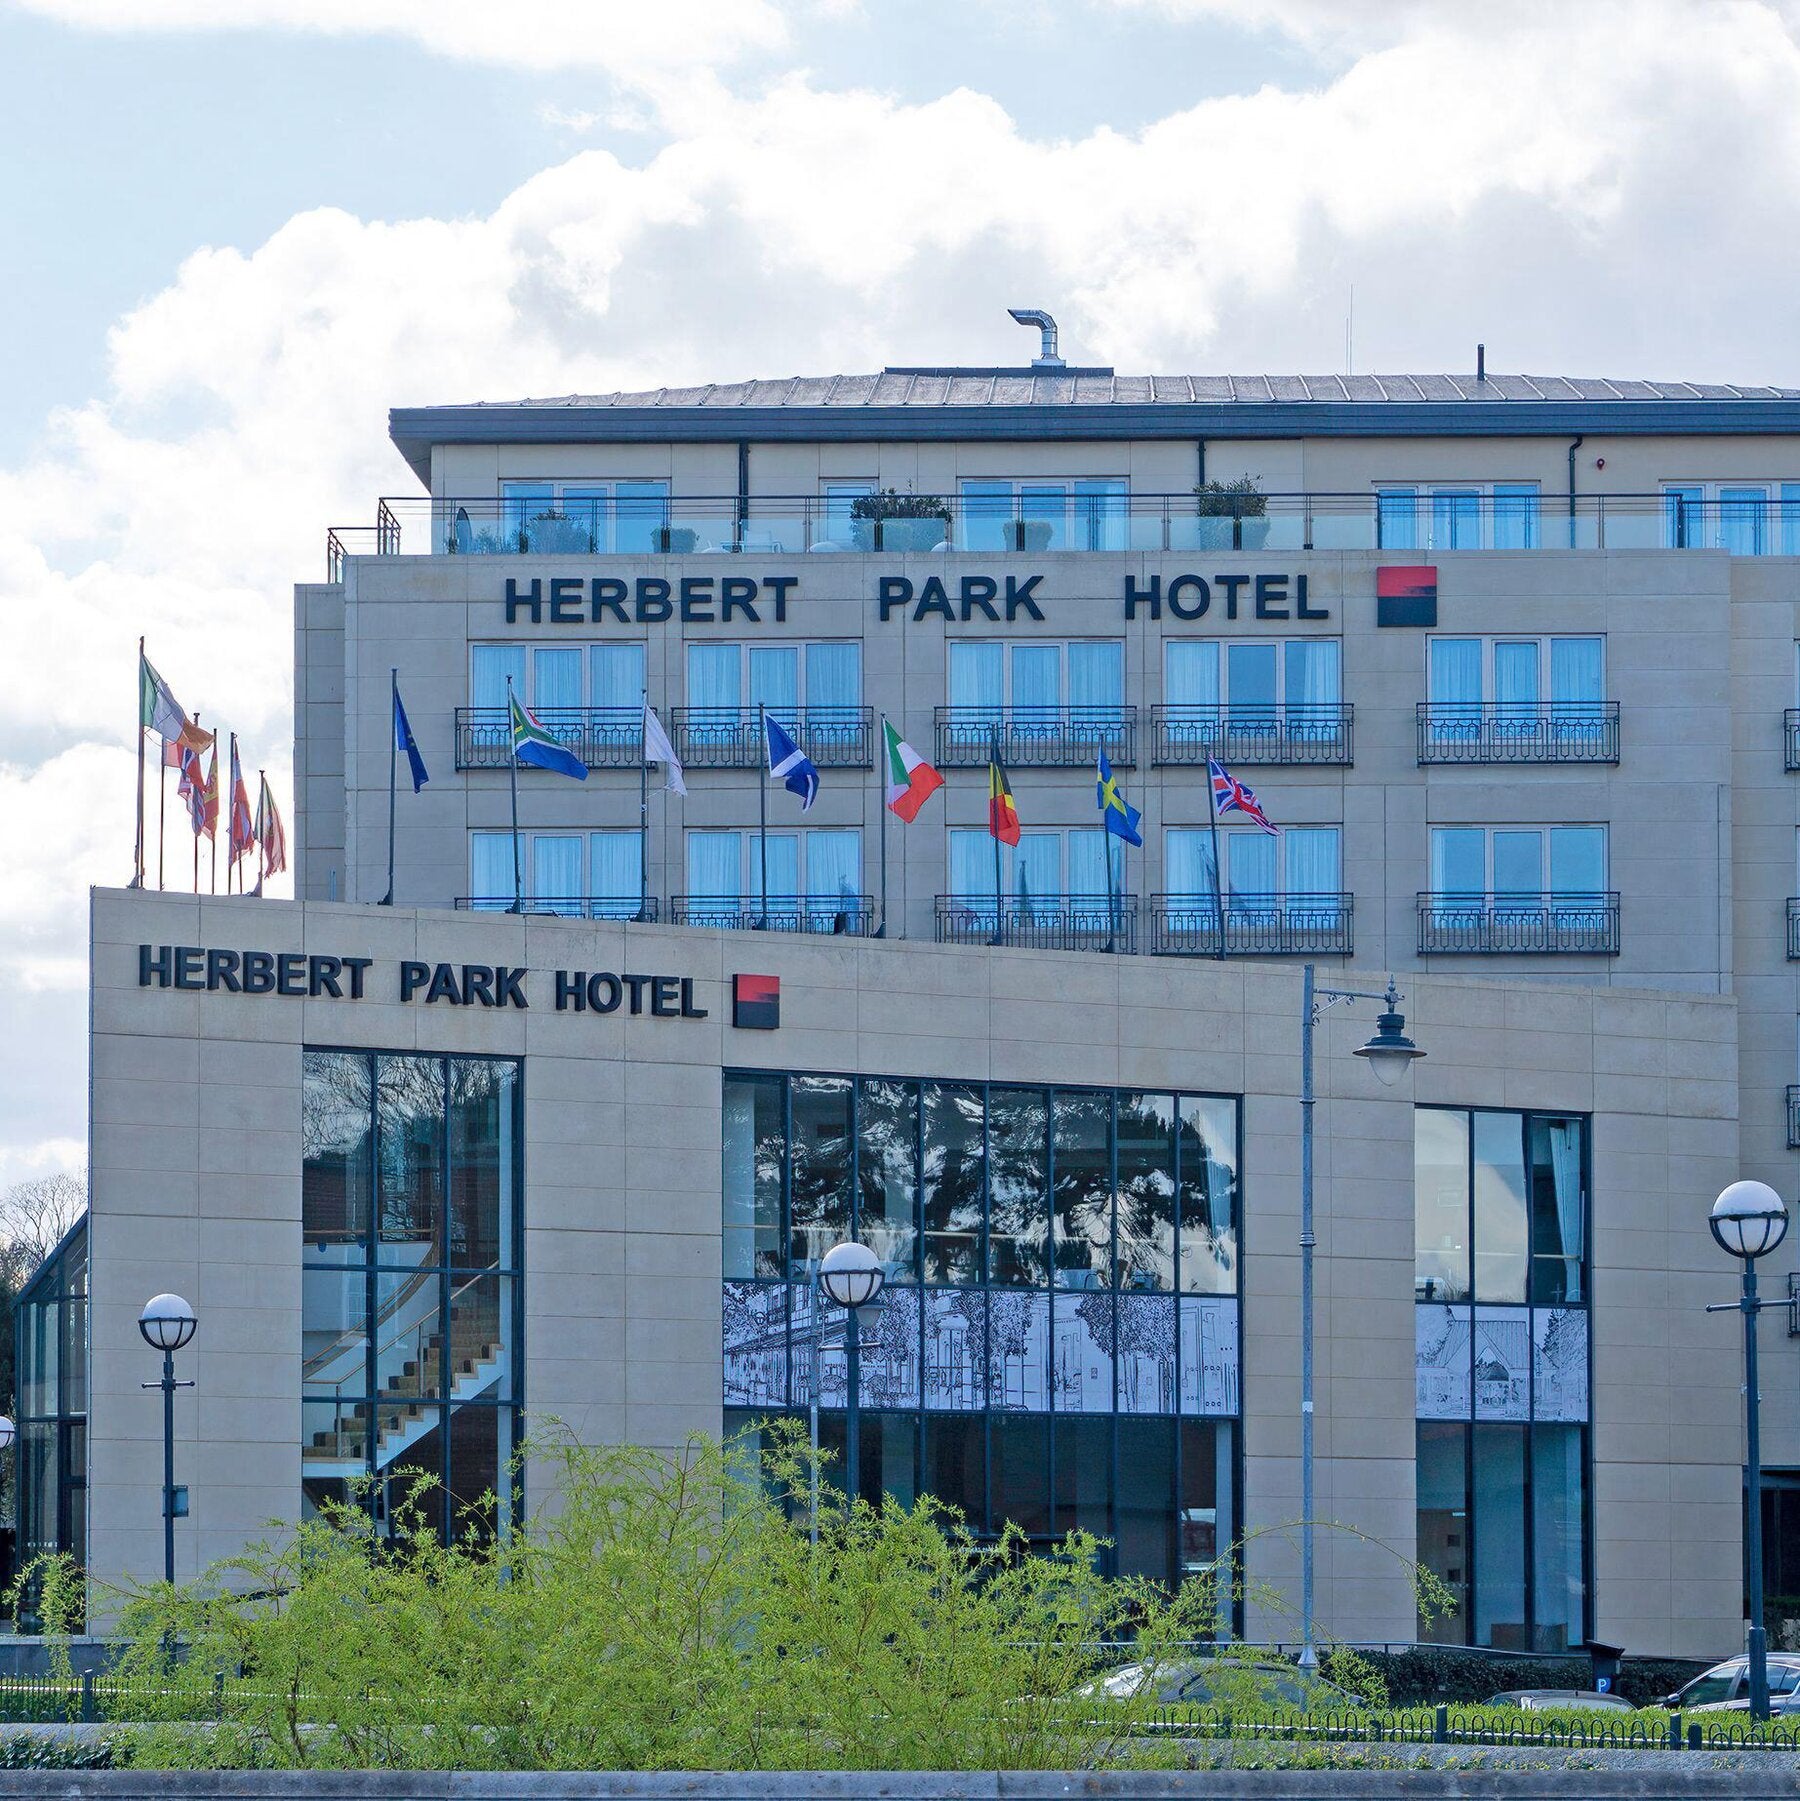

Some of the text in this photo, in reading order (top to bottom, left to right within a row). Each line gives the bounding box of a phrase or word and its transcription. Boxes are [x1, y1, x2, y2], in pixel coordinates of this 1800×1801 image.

[505, 574, 1329, 624] HERBERT PARK HOTEL
[139, 945, 708, 1018] HERBERT PARK HOTEL
[1598, 1678, 1607, 1693] P
